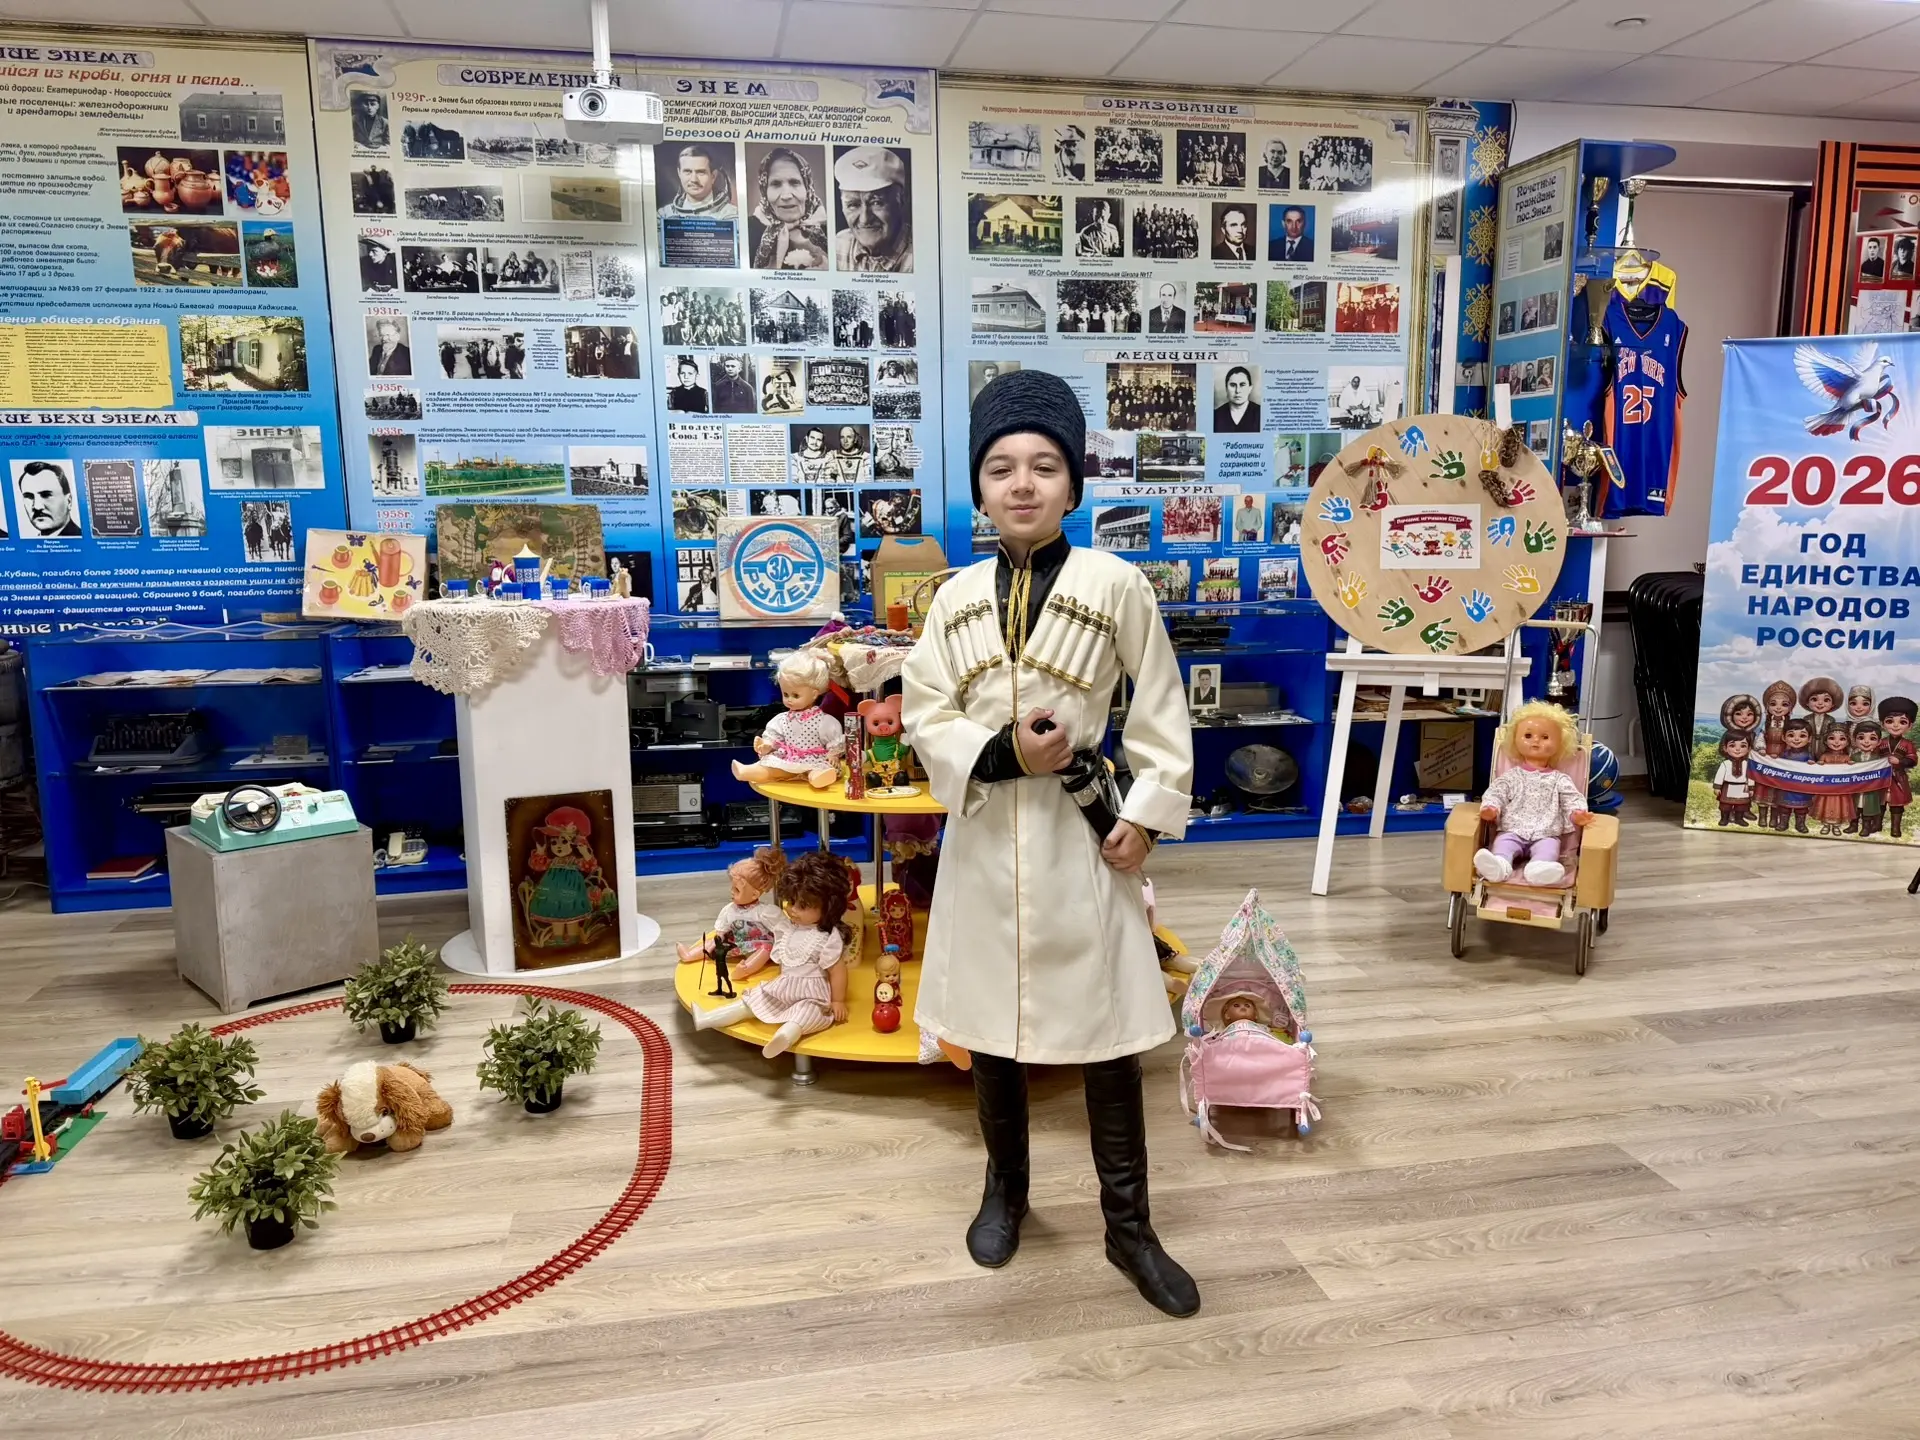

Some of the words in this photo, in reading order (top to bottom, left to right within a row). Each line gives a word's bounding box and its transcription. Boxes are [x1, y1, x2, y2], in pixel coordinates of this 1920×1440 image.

[48, 50, 140, 64] ЭНЕМА
[44, 68, 63, 78] из
[130, 72, 171, 84] огня
[176, 75, 186, 84] и
[461, 68, 621, 88] СОВРЕМЕННЙ
[676, 80, 768, 96] ЭНЕМ
[12, 84, 44, 94] дороги:
[46, 86, 107, 96] Екатеринодар
[114, 88, 172, 98] Новороссийск
[20, 98, 76, 108] поселенцы:
[78, 102, 168, 111] железнодорожники
[475, 98, 509, 106] образован
[1103, 99, 1238, 114] ОБРАЗОВАНИЕ
[16, 108, 78, 118] арендаторы
[80, 110, 144, 120] земледельцы
[692, 108, 729, 117] АДЫГОВ,
[730, 109, 777, 118] ВЫРОСШИЙ
[779, 112, 807, 120] ЗДЕСЬ,
[825, 113, 864, 122] МОЛОДОЙ
[773, 104, 810, 112] ЧЕЛОВЕК,
[812, 105, 866, 114] РОДИВШИЙСЯ
[719, 117, 752, 126] КРЫЛЬЯ
[754, 118, 770, 127] ДЛЯ
[772, 120, 830, 129] ДАЛЬНЕЙШЕГО
[1151, 120, 1200, 129] Образовательная
[665, 127, 740, 140] Березовой
[745, 129, 817, 141] Анатолий
[821, 134, 901, 144] Николаевич
[1148, 190, 1197, 198] Образовательная
[360, 228, 395, 236] 1929г.
[105, 286, 137, 294] февраля
[41, 314, 93, 324] общего
[97, 316, 160, 325] собрания
[1116, 351, 1219, 361] МЕДИЦИНА
[1623, 385, 1655, 425] 25
[38, 413, 96, 424] ВЕХИ
[102, 413, 179, 424] ЭНЕМА
[1219, 469, 1240, 478] дарят
[1744, 454, 1920, 506] 2026
[1121, 486, 1214, 495] КУЛЬТУРА
[376, 510, 414, 520] 1958г.
[1800, 533, 1866, 558] ГОД
[769, 556, 790, 580] ЗА
[1742, 564, 1920, 588] ЕДИНСТВА
[743, 568, 816, 606] РУЛЕМ
[14, 607, 54, 615] февраля
[62, 606, 123, 615] фашистская
[1748, 595, 1910, 622] НАРОДОВ
[1756, 627, 1895, 650] РОССИИ
[1763, 767, 1792, 778] дружбе
[1792, 775, 1824, 783] народов
[1851, 771, 1880, 782] России!
